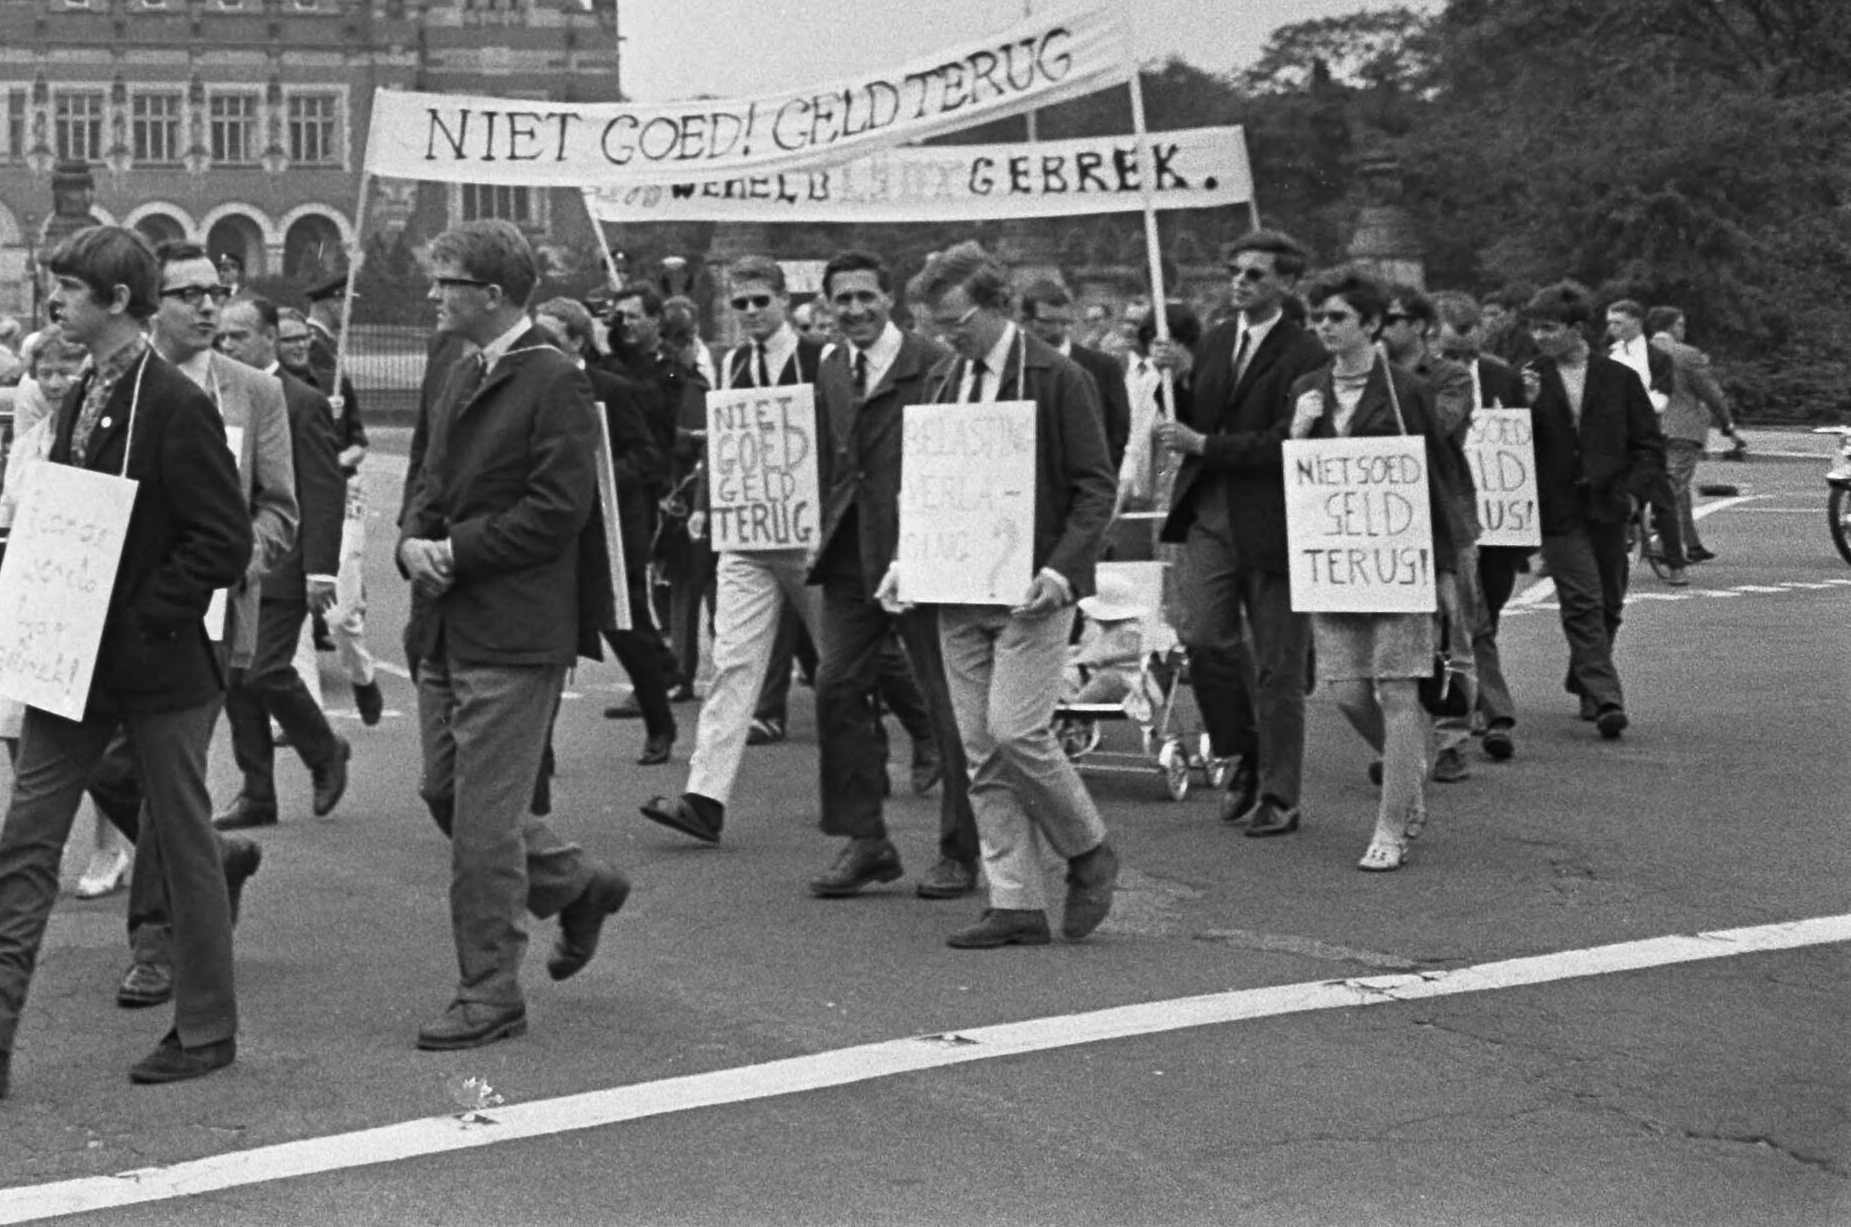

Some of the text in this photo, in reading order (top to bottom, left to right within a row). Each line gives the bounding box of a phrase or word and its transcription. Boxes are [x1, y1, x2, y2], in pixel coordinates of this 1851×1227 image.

[424, 26, 1075, 165] NIET GOED! GELD TERUG
[969, 142, 1220, 197] GEBREK.
[714, 397, 793, 432] NIET
[716, 426, 810, 475] GOED
[1297, 456, 1350, 487] NIET
[1478, 450, 1527, 493] LD
[718, 472, 796, 503] GELD
[710, 500, 813, 545] TERUG
